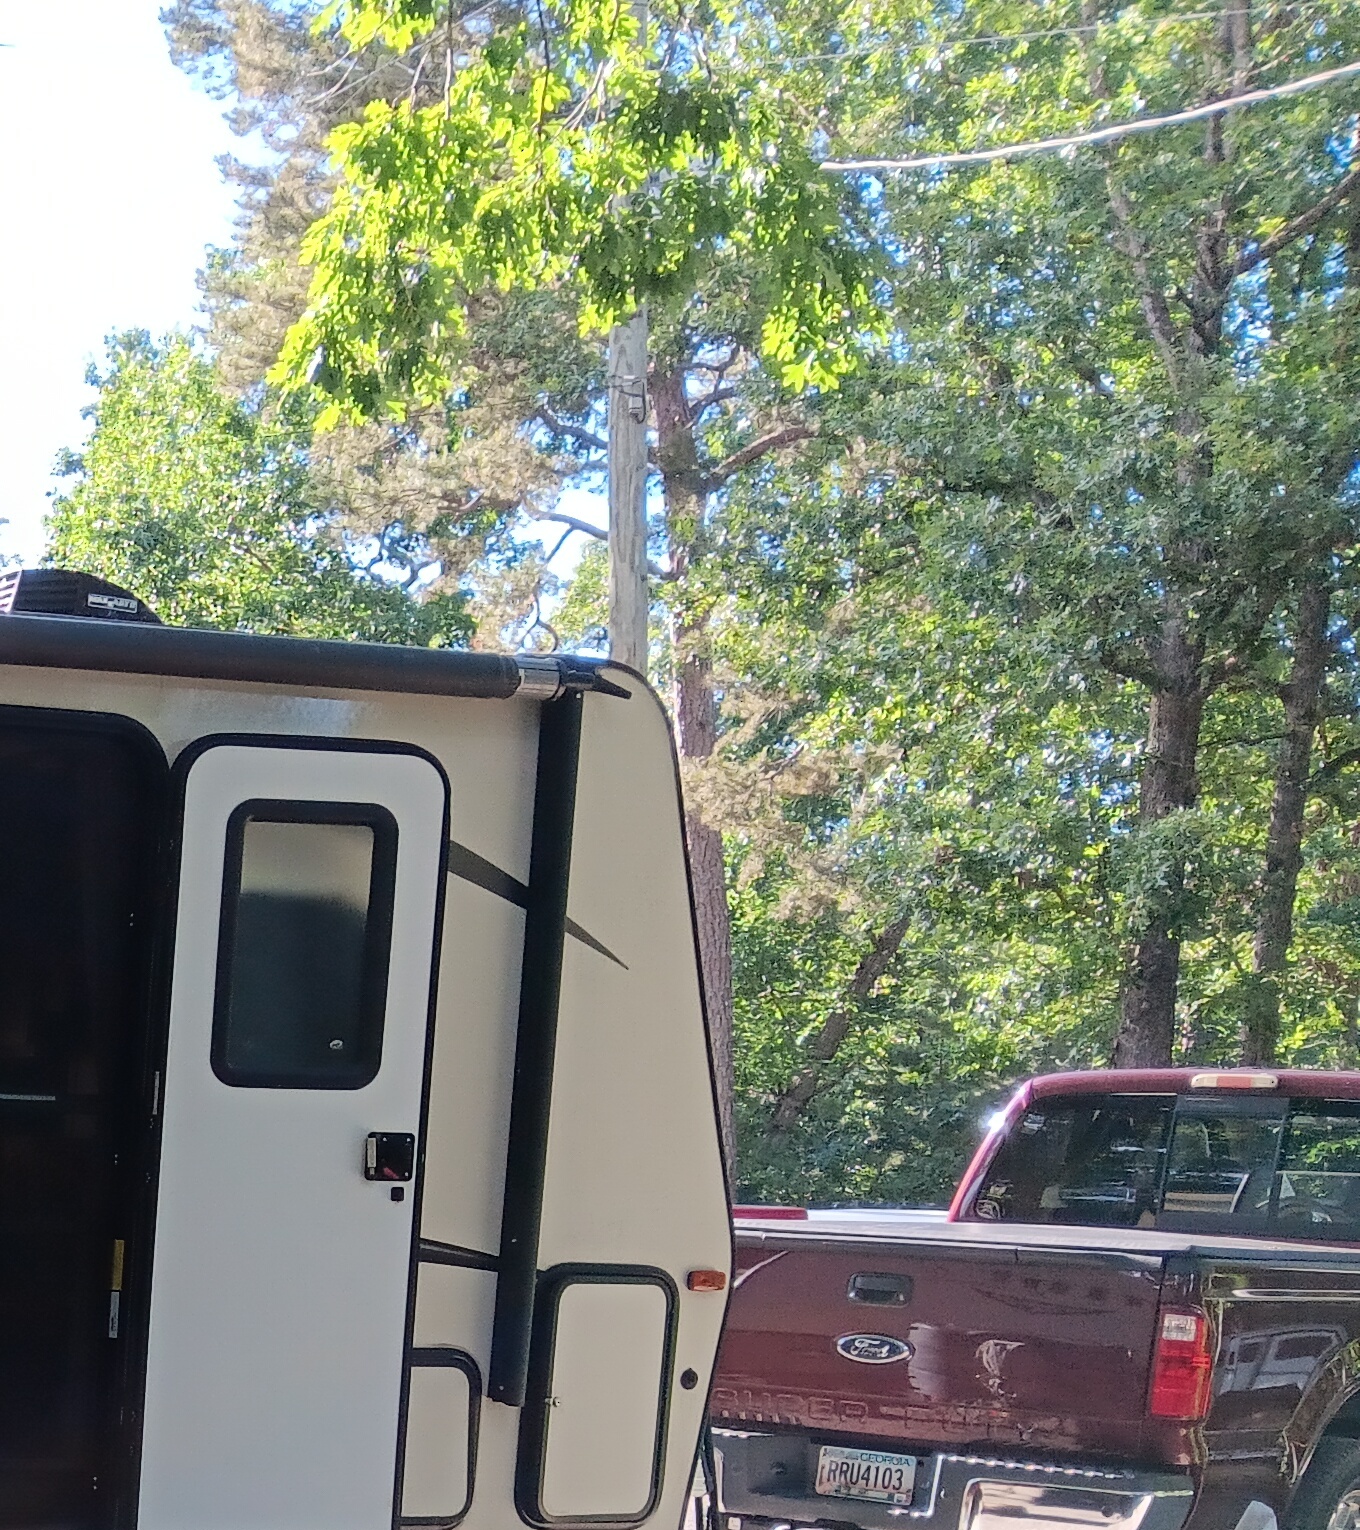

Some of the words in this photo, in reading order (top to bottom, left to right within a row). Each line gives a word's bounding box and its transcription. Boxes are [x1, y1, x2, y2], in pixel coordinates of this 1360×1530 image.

[850, 1338, 890, 1358] Ford
[860, 1453, 910, 1467] GEORGIA
[827, 1460, 904, 1491] RRU4103
